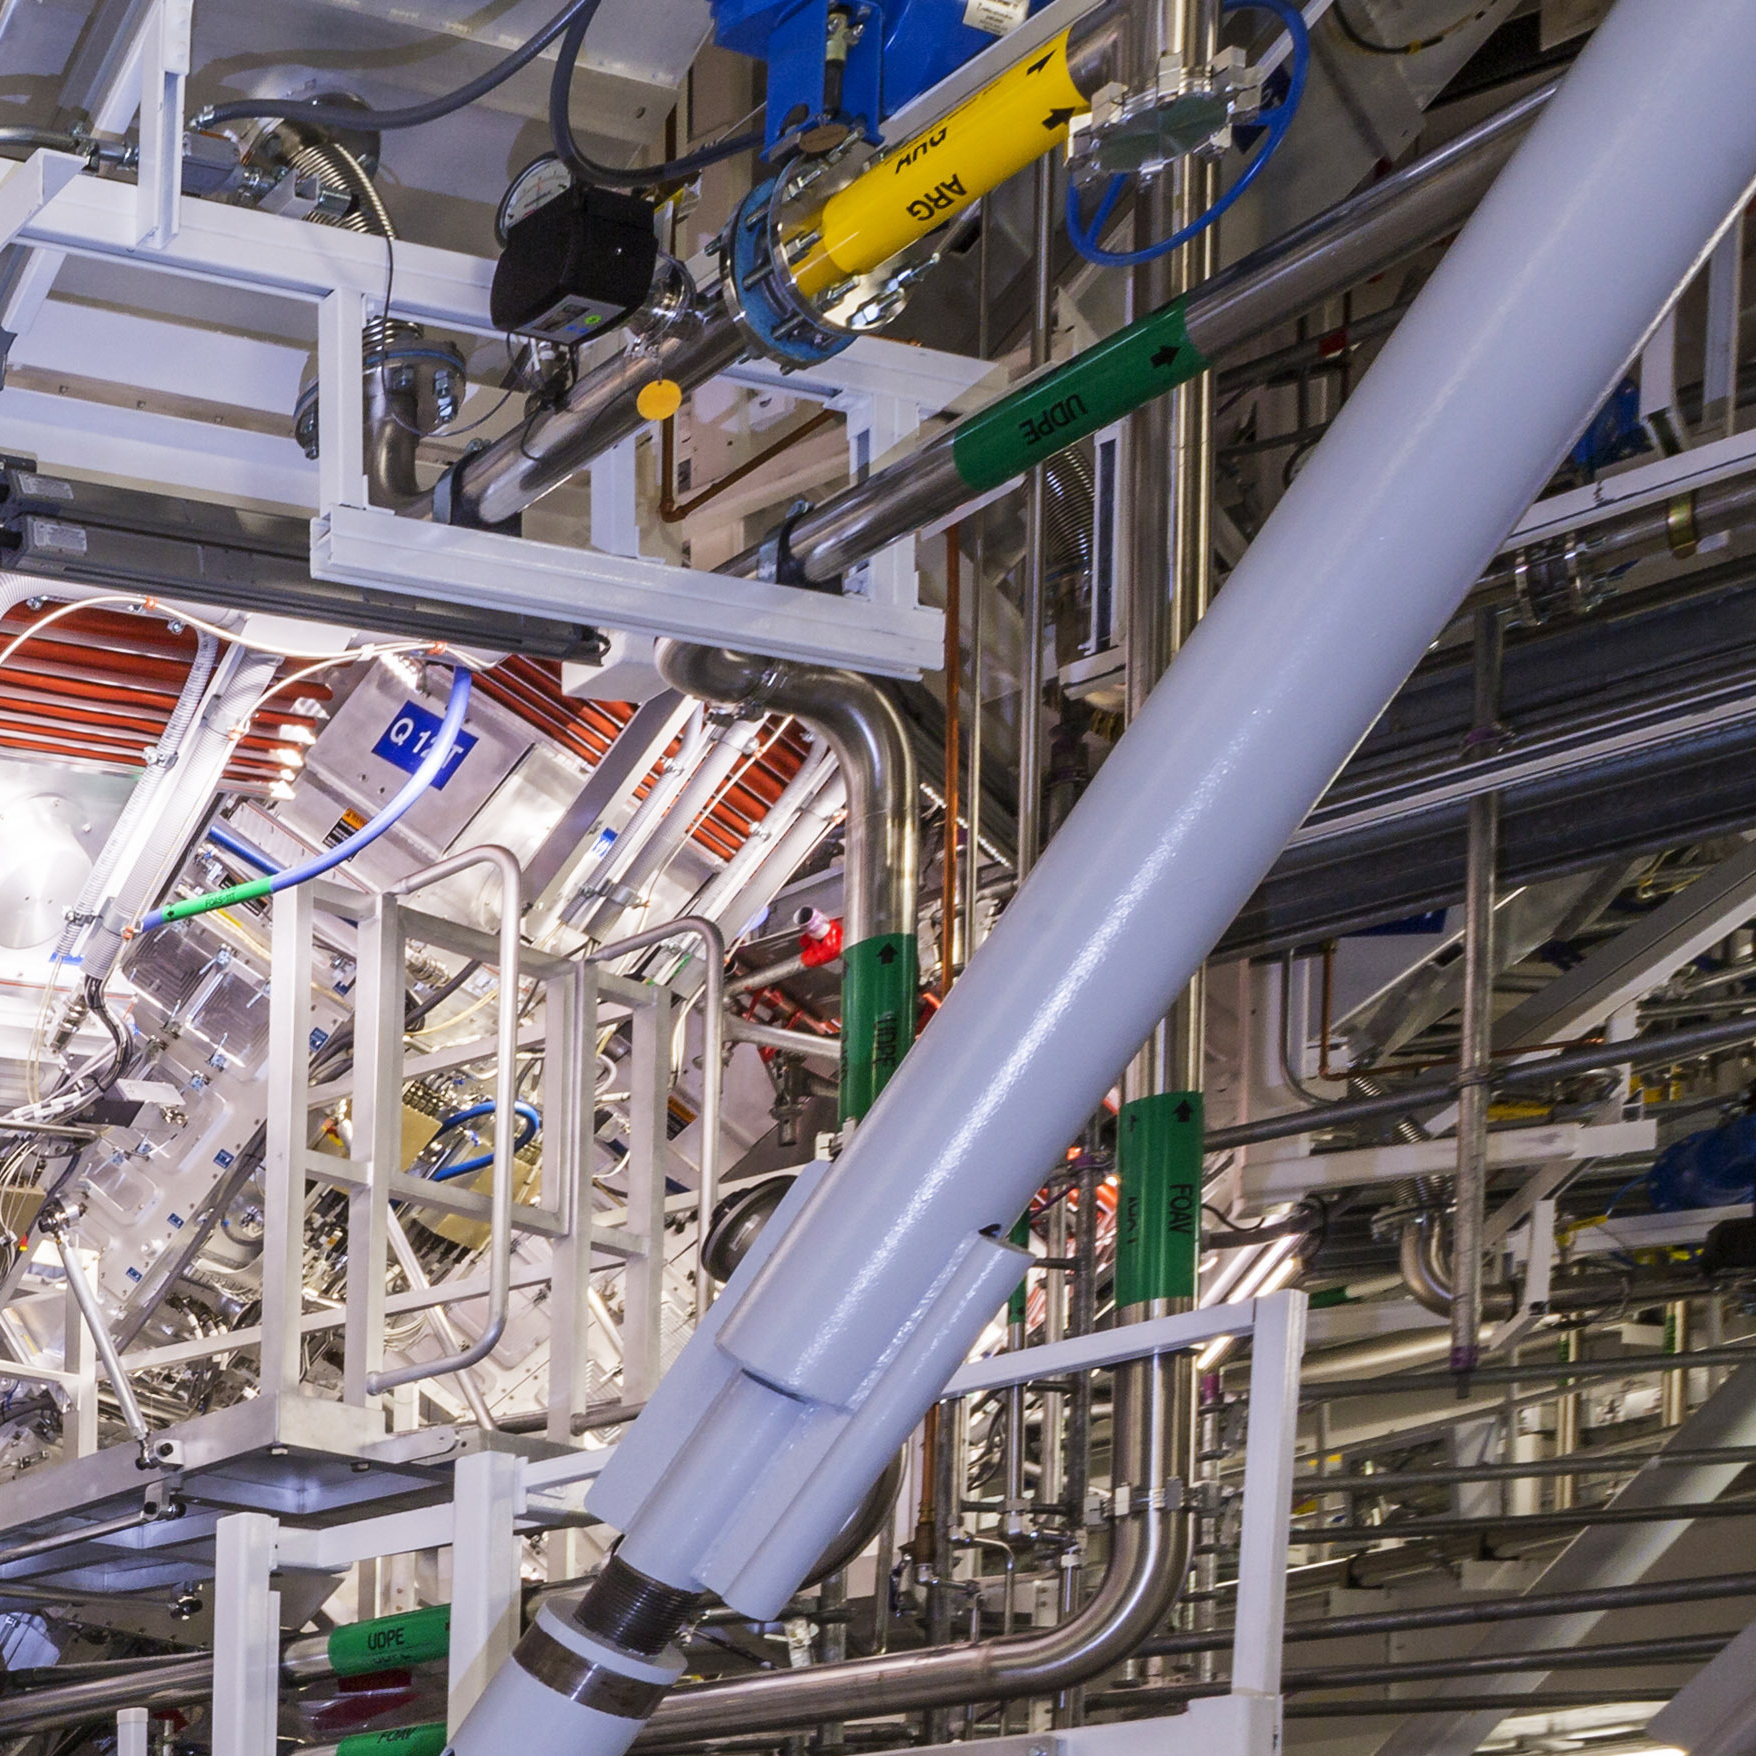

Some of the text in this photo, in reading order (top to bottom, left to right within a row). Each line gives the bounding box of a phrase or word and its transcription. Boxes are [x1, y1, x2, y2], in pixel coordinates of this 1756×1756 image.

[906, 174, 968, 221] ARG
[1019, 394, 1089, 446] UDPE
[390, 717, 414, 746] Q
[1169, 1184, 1194, 1234] FOAV
[367, 1627, 405, 1650] UDPE
